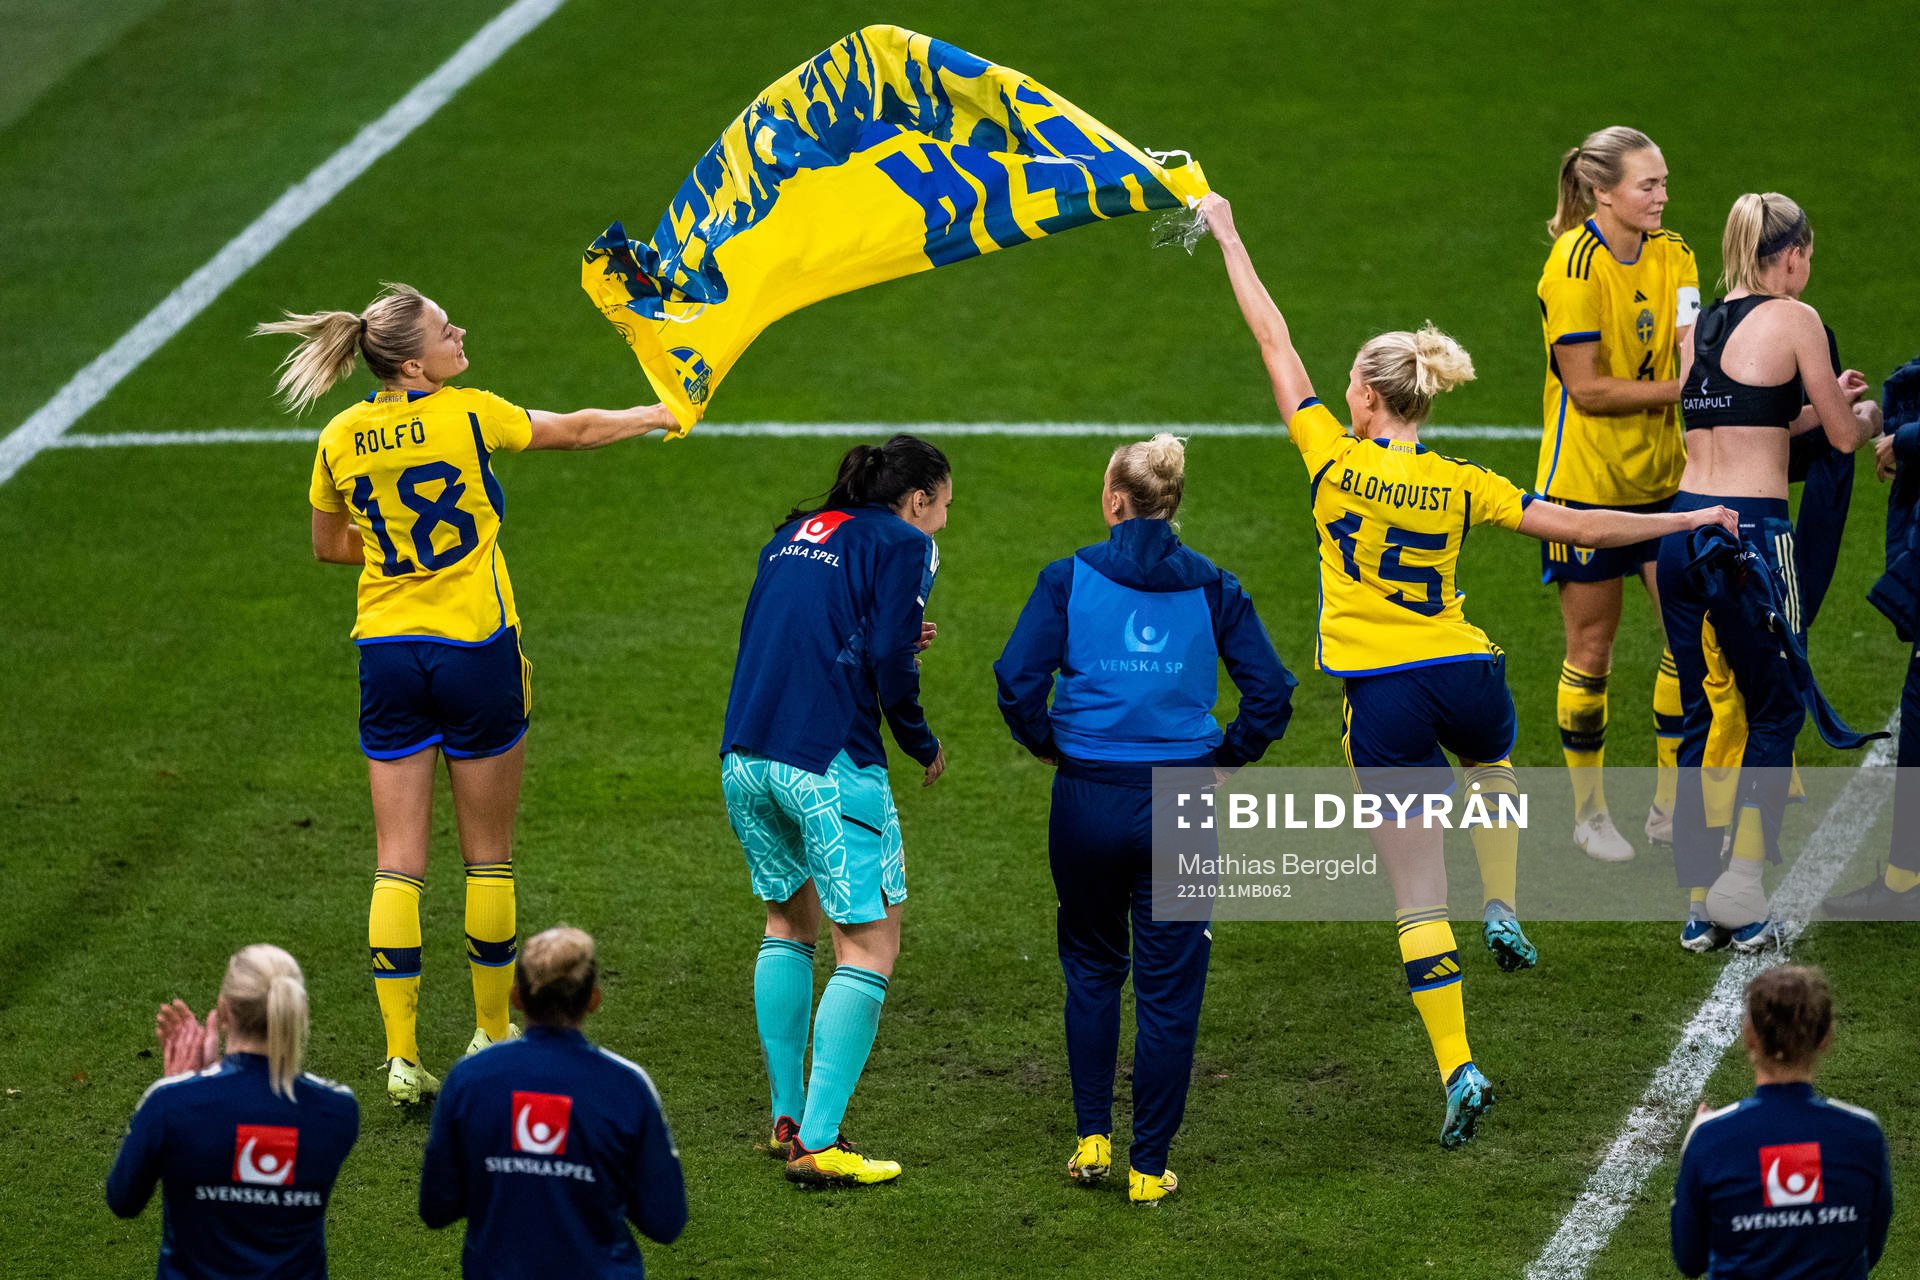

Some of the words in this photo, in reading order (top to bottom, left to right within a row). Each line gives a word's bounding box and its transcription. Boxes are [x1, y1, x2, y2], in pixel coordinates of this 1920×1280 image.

[1637, 350, 1654, 380] 4
[1683, 395, 1733, 410] CATAPULT
[354, 417, 426, 456] ROLFÖ
[1340, 468, 1452, 511] BLOMQVIST
[352, 460, 479, 576] 18
[810, 549, 840, 568] SPEL
[1325, 511, 1449, 617] 15
[1100, 659, 1160, 673] VENSKA
[1164, 661, 1184, 674] SP
[553, 1160, 596, 1183] SPEL
[195, 1185, 280, 1206] SVENSKA
[282, 1190, 322, 1207] SPEL
[1731, 1209, 1814, 1232] SVENSKA
[1817, 1206, 1858, 1225] SPEL
